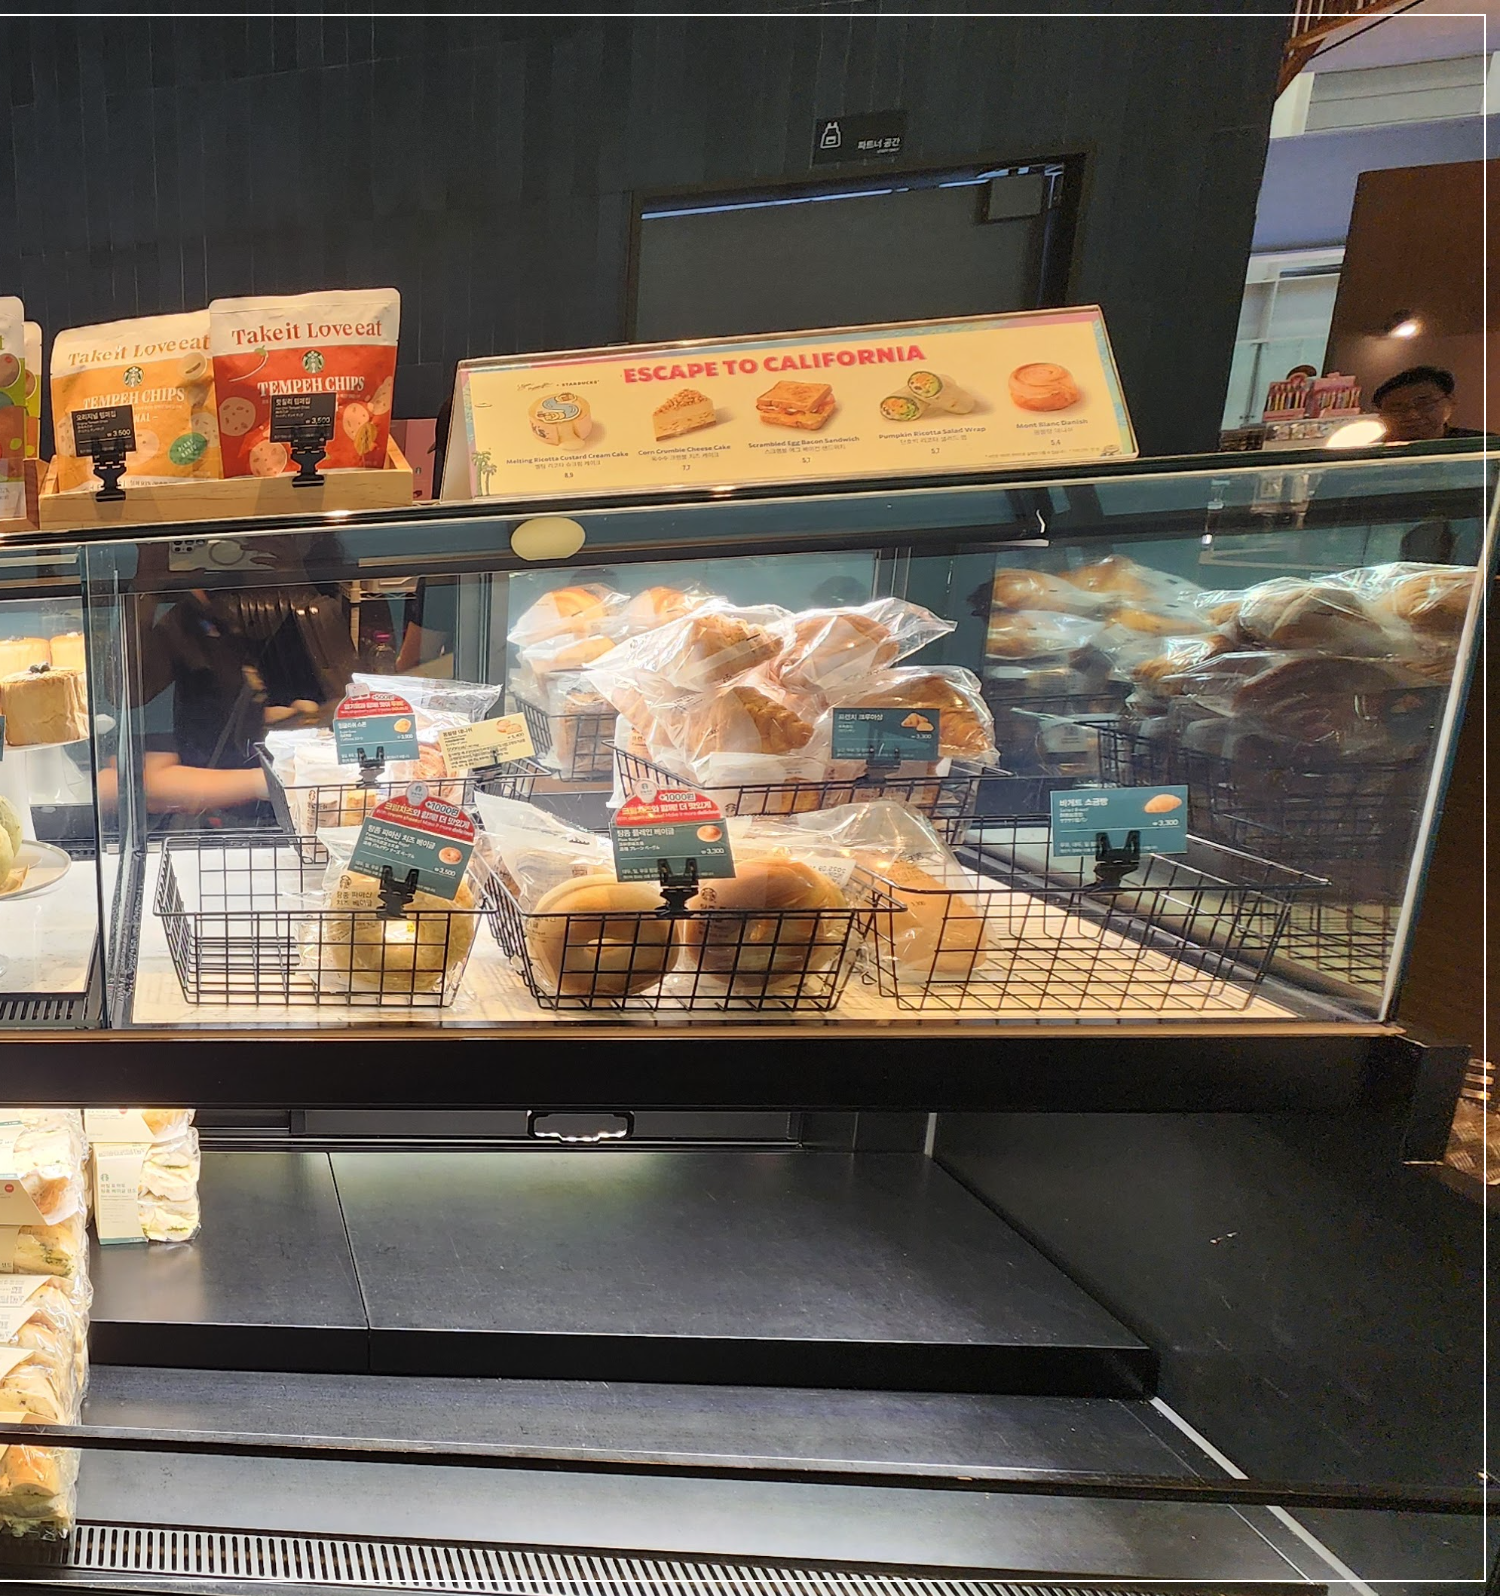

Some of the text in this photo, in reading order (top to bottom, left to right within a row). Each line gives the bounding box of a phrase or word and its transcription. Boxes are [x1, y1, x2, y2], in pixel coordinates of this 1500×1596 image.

[858, 137, 901, 150] 파트너 공간
[232, 325, 284, 345] Take
[307, 321, 352, 338] Love
[68, 348, 113, 366] Take
[133, 340, 177, 358] Love
[623, 345, 927, 384] ESCAPE TO CALIFORNIA
[258, 376, 365, 396] TEMPEH CHIPS
[83, 387, 186, 409] TEMPEH CHIPS
[1061, 418, 1089, 426] Danish
[748, 440, 787, 448] Scrambled
[825, 436, 860, 444] Sandwich
[879, 432, 912, 440] Pumpkin
[858, 713, 883, 721] 크루아상
[660, 793, 695, 802] +1000원
[1059, 797, 1109, 807] 바게트 소금빵
[426, 801, 460, 816] +1000원
[382, 829, 402, 840] 파마산
[402, 835, 416, 843] 치즈
[416, 839, 436, 849] 베이글
